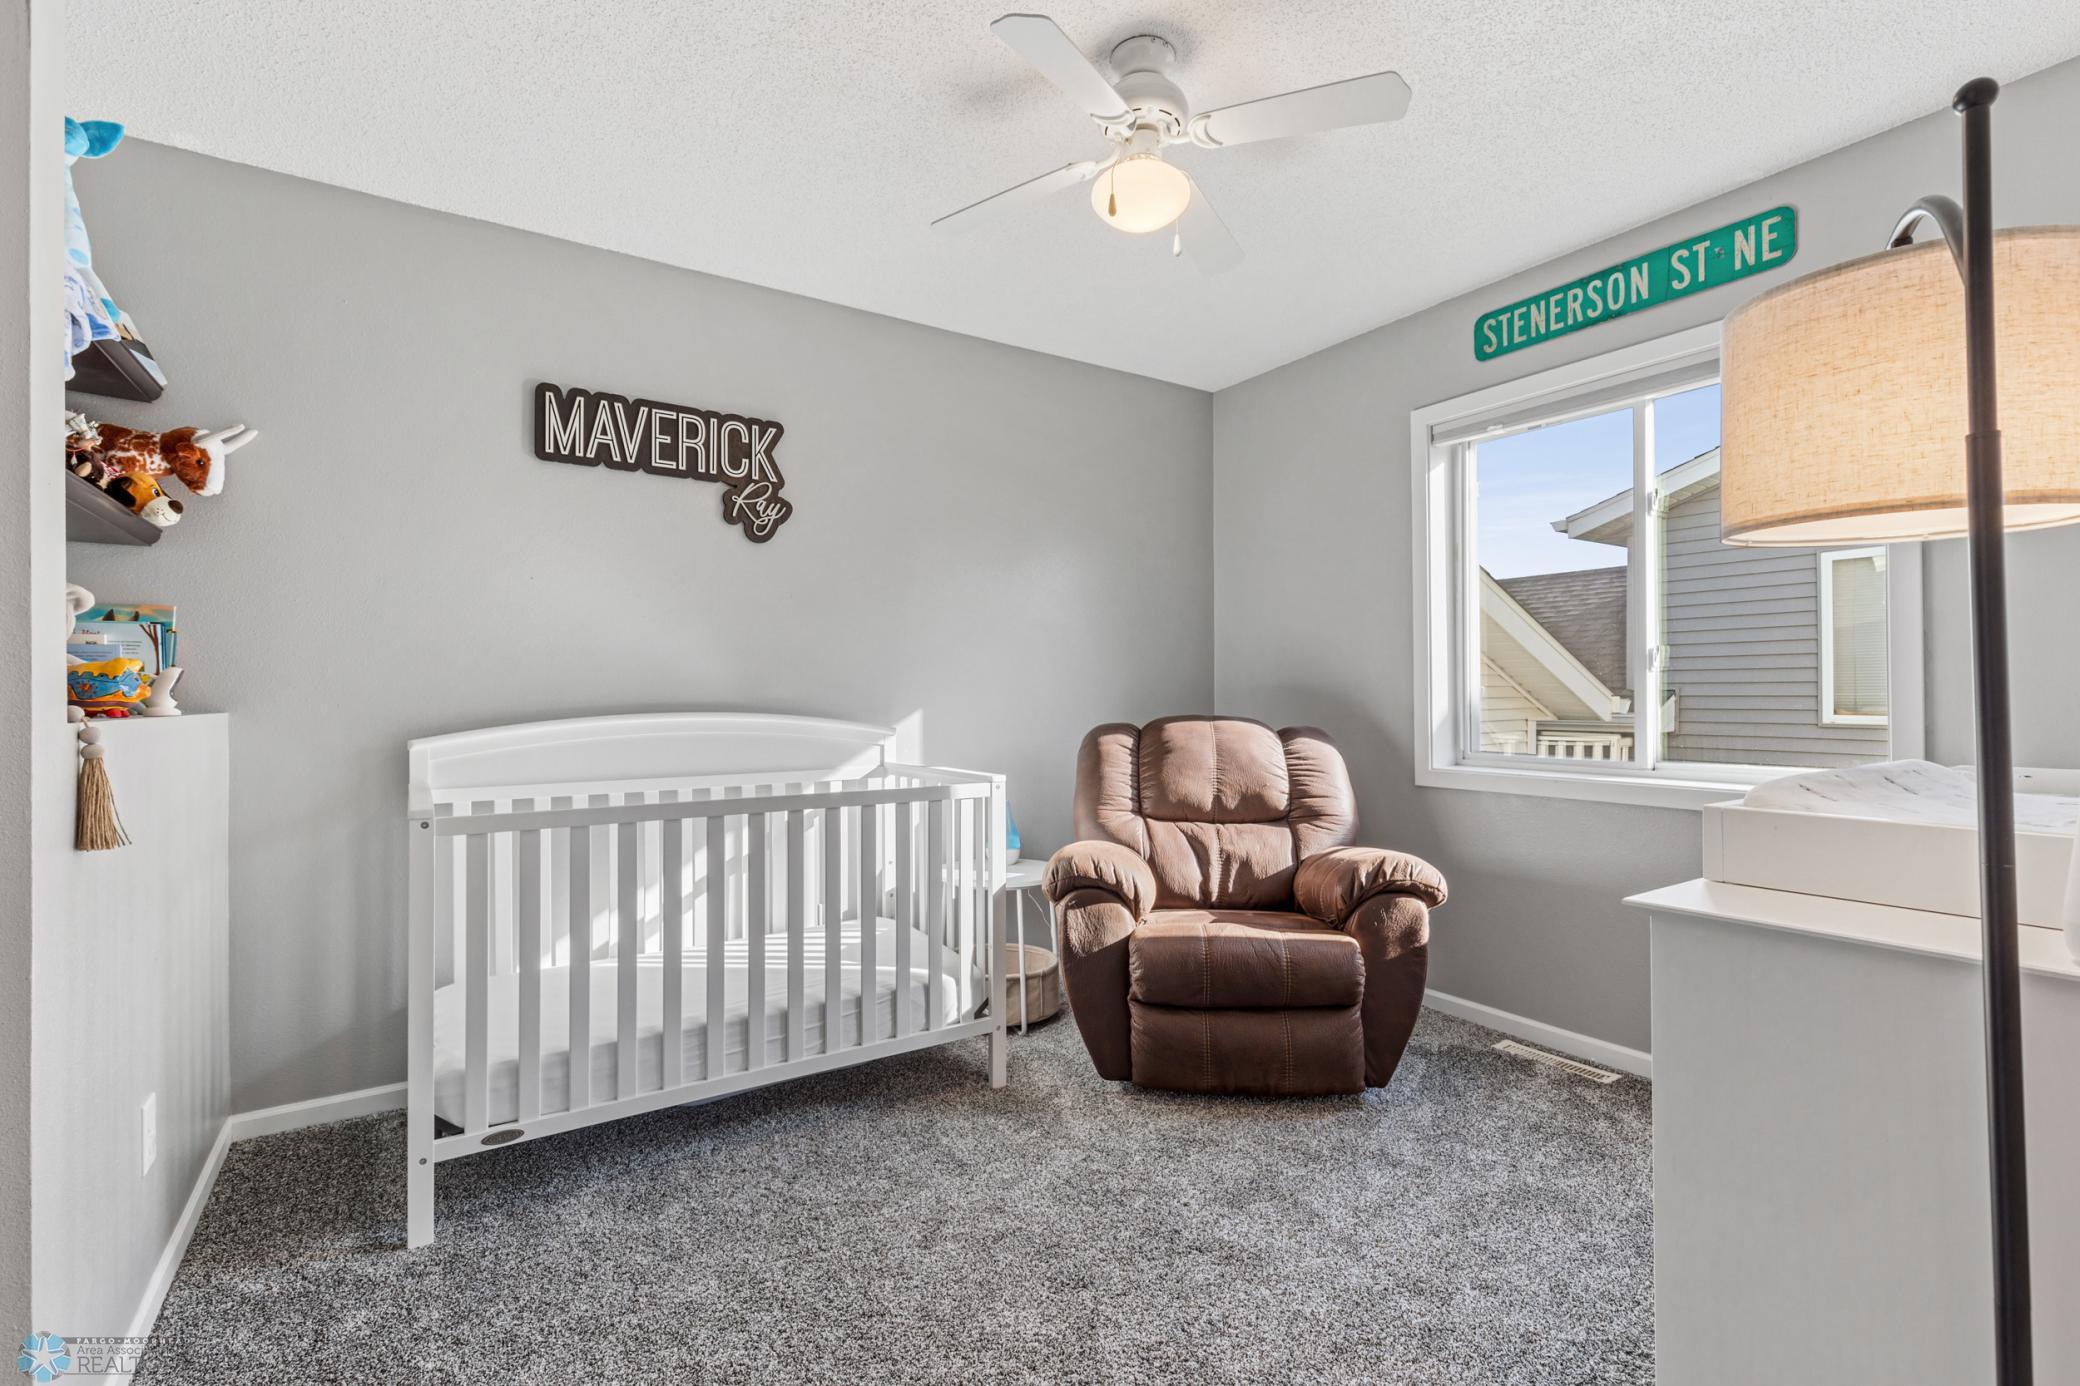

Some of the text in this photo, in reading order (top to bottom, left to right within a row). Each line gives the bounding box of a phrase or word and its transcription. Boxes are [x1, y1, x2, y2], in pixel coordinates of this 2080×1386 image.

[1483, 215, 1783, 353] STENERSON ST NE
[545, 391, 777, 482] MAVERICK
[732, 482, 786, 535] Ray
